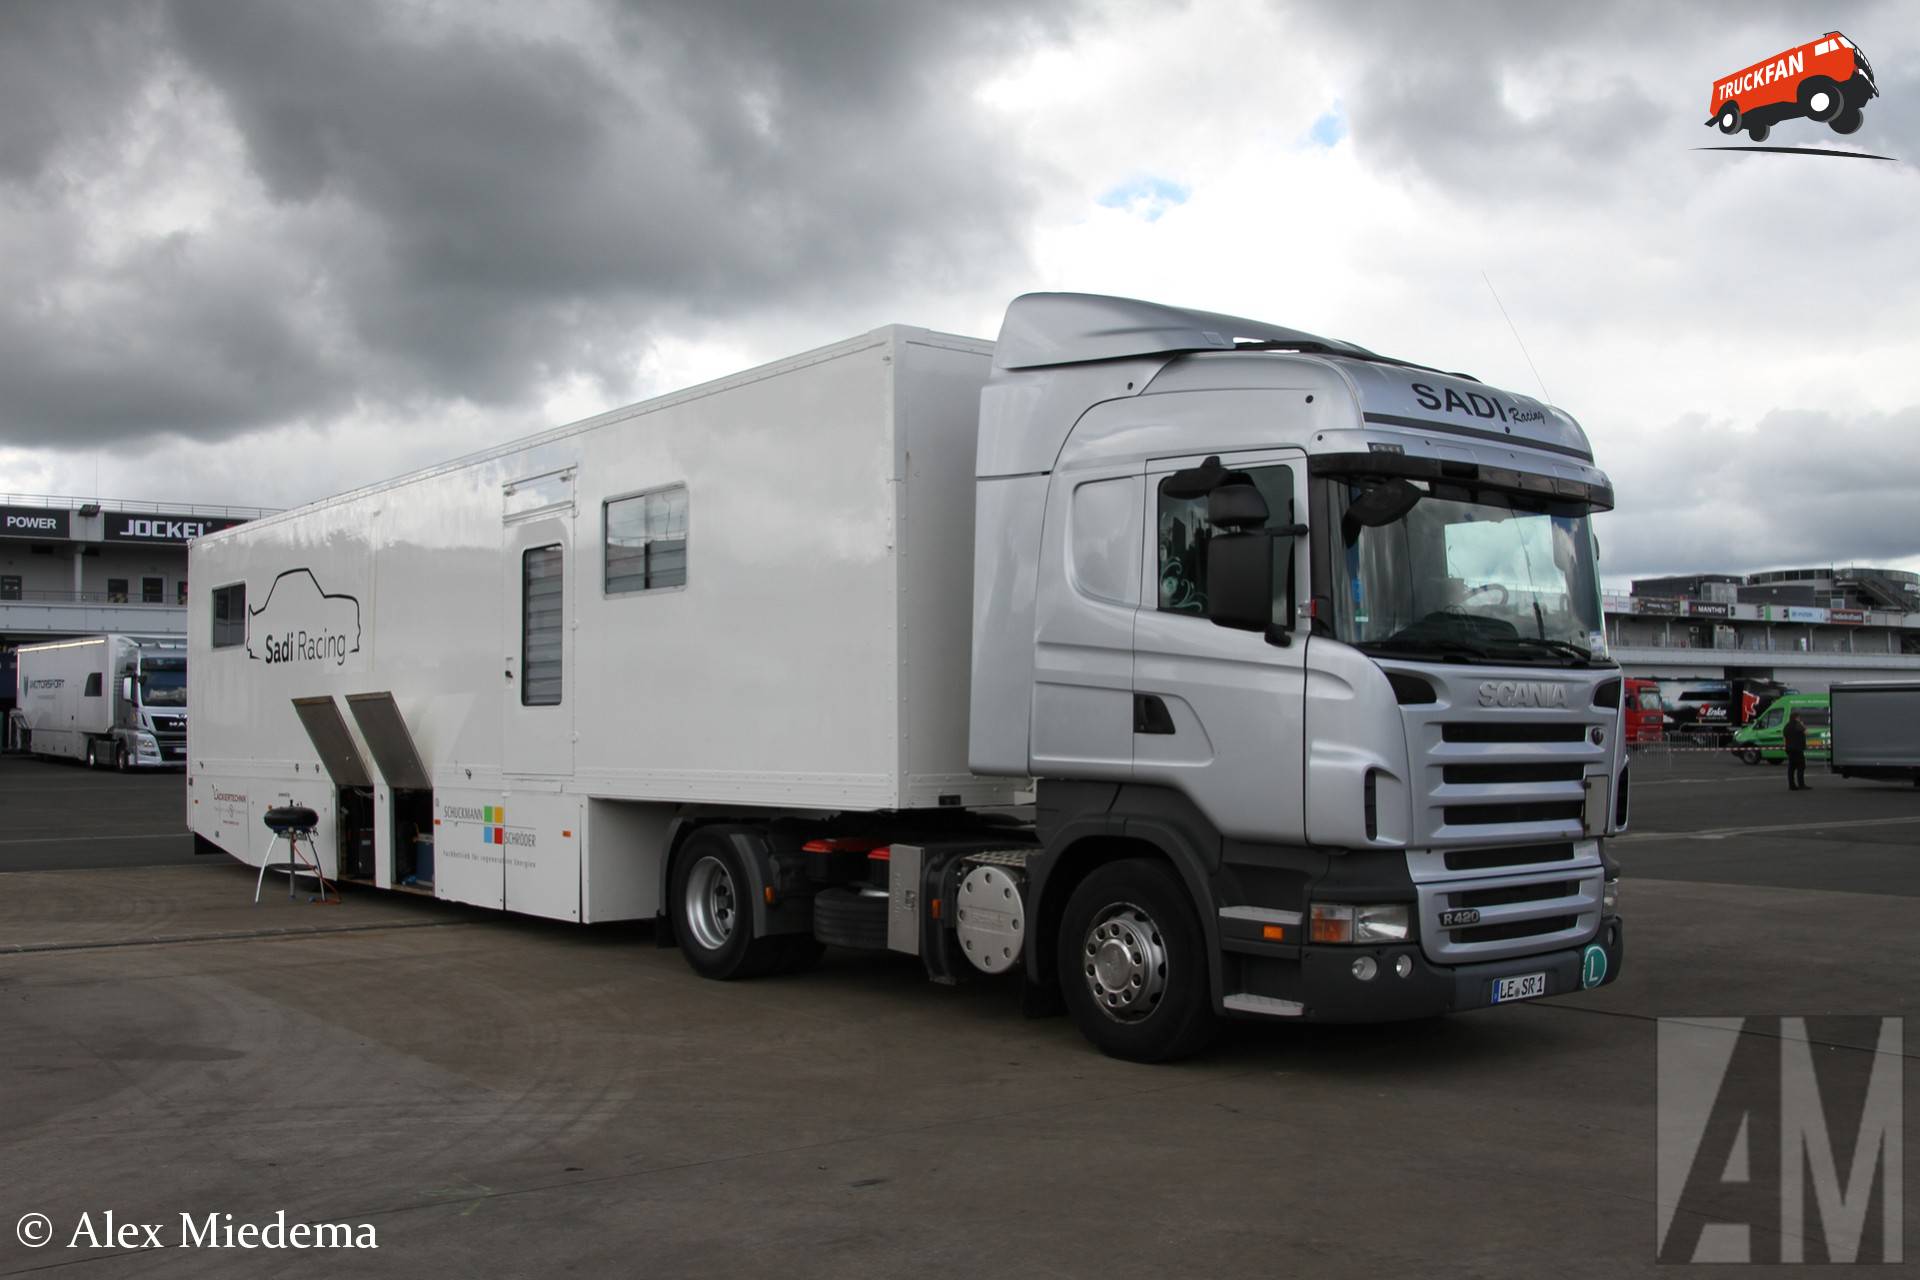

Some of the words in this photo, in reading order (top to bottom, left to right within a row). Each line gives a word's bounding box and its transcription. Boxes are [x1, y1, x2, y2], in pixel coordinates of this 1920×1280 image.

[1411, 383, 1507, 422] SADI
[1508, 407, 1546, 425] Racing
[7, 516, 56, 529] POWER
[265, 631, 293, 664] Sadi
[298, 628, 345, 666] Racing
[1478, 680, 1568, 708] SCANIA
[1443, 913, 1452, 925] R
[1454, 911, 1479, 924] 420
